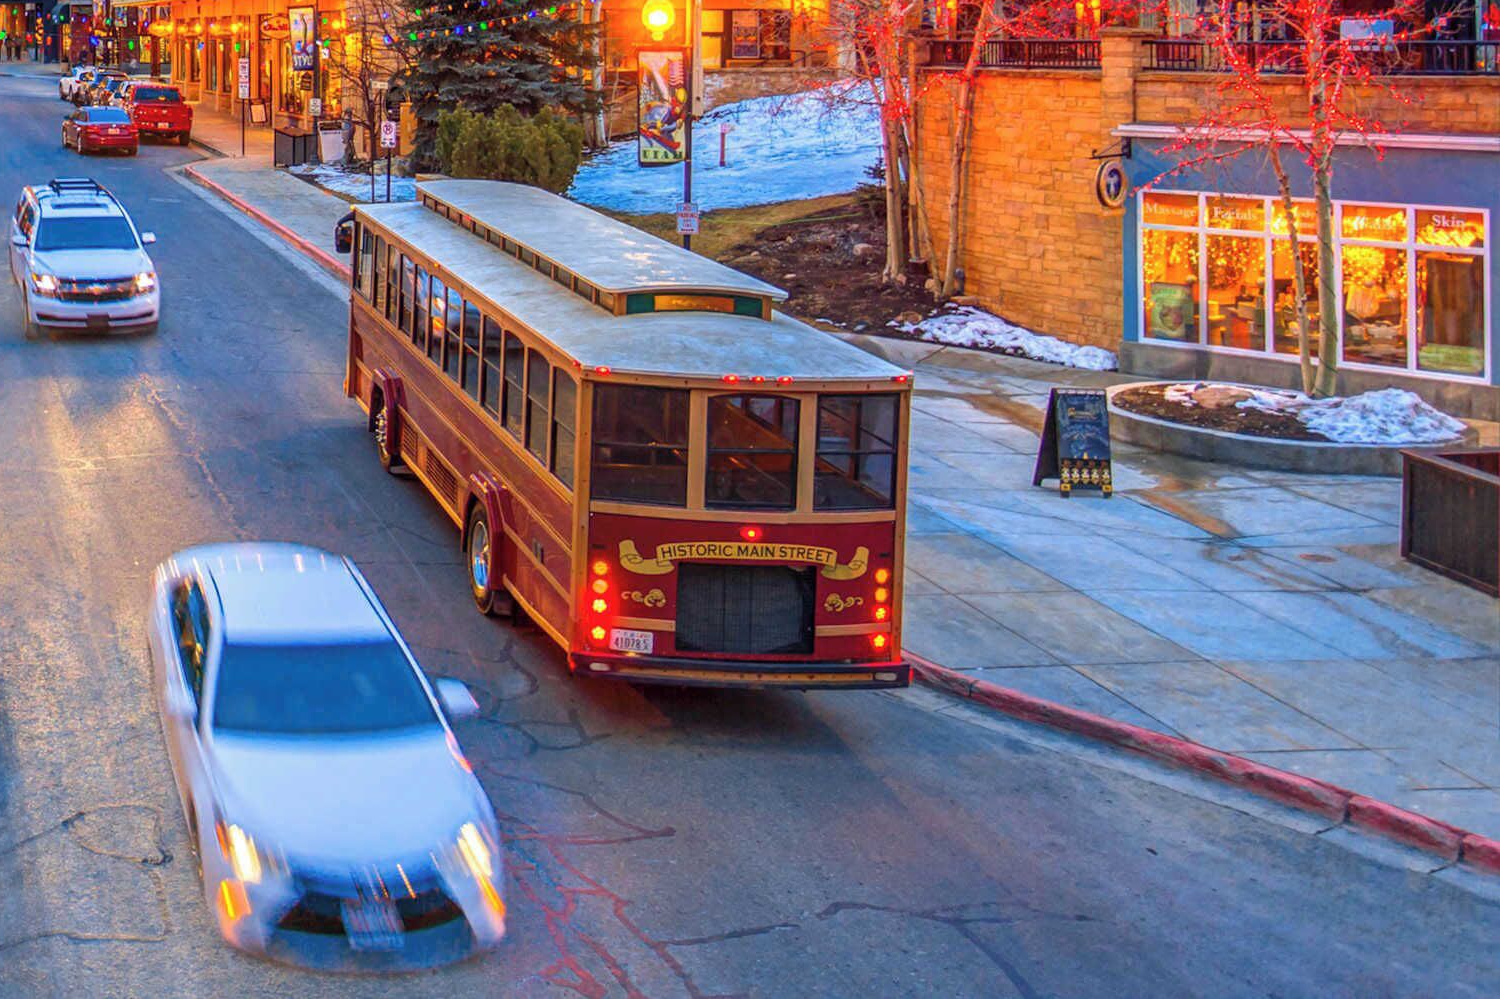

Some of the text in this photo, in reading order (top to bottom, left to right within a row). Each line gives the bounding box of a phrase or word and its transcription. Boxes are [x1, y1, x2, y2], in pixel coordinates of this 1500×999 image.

[642, 150, 683, 160] UTAH
[1145, 203, 1466, 229] Massage Facials Skin
[661, 544, 833, 563] HISTORIC MAIN STREET
